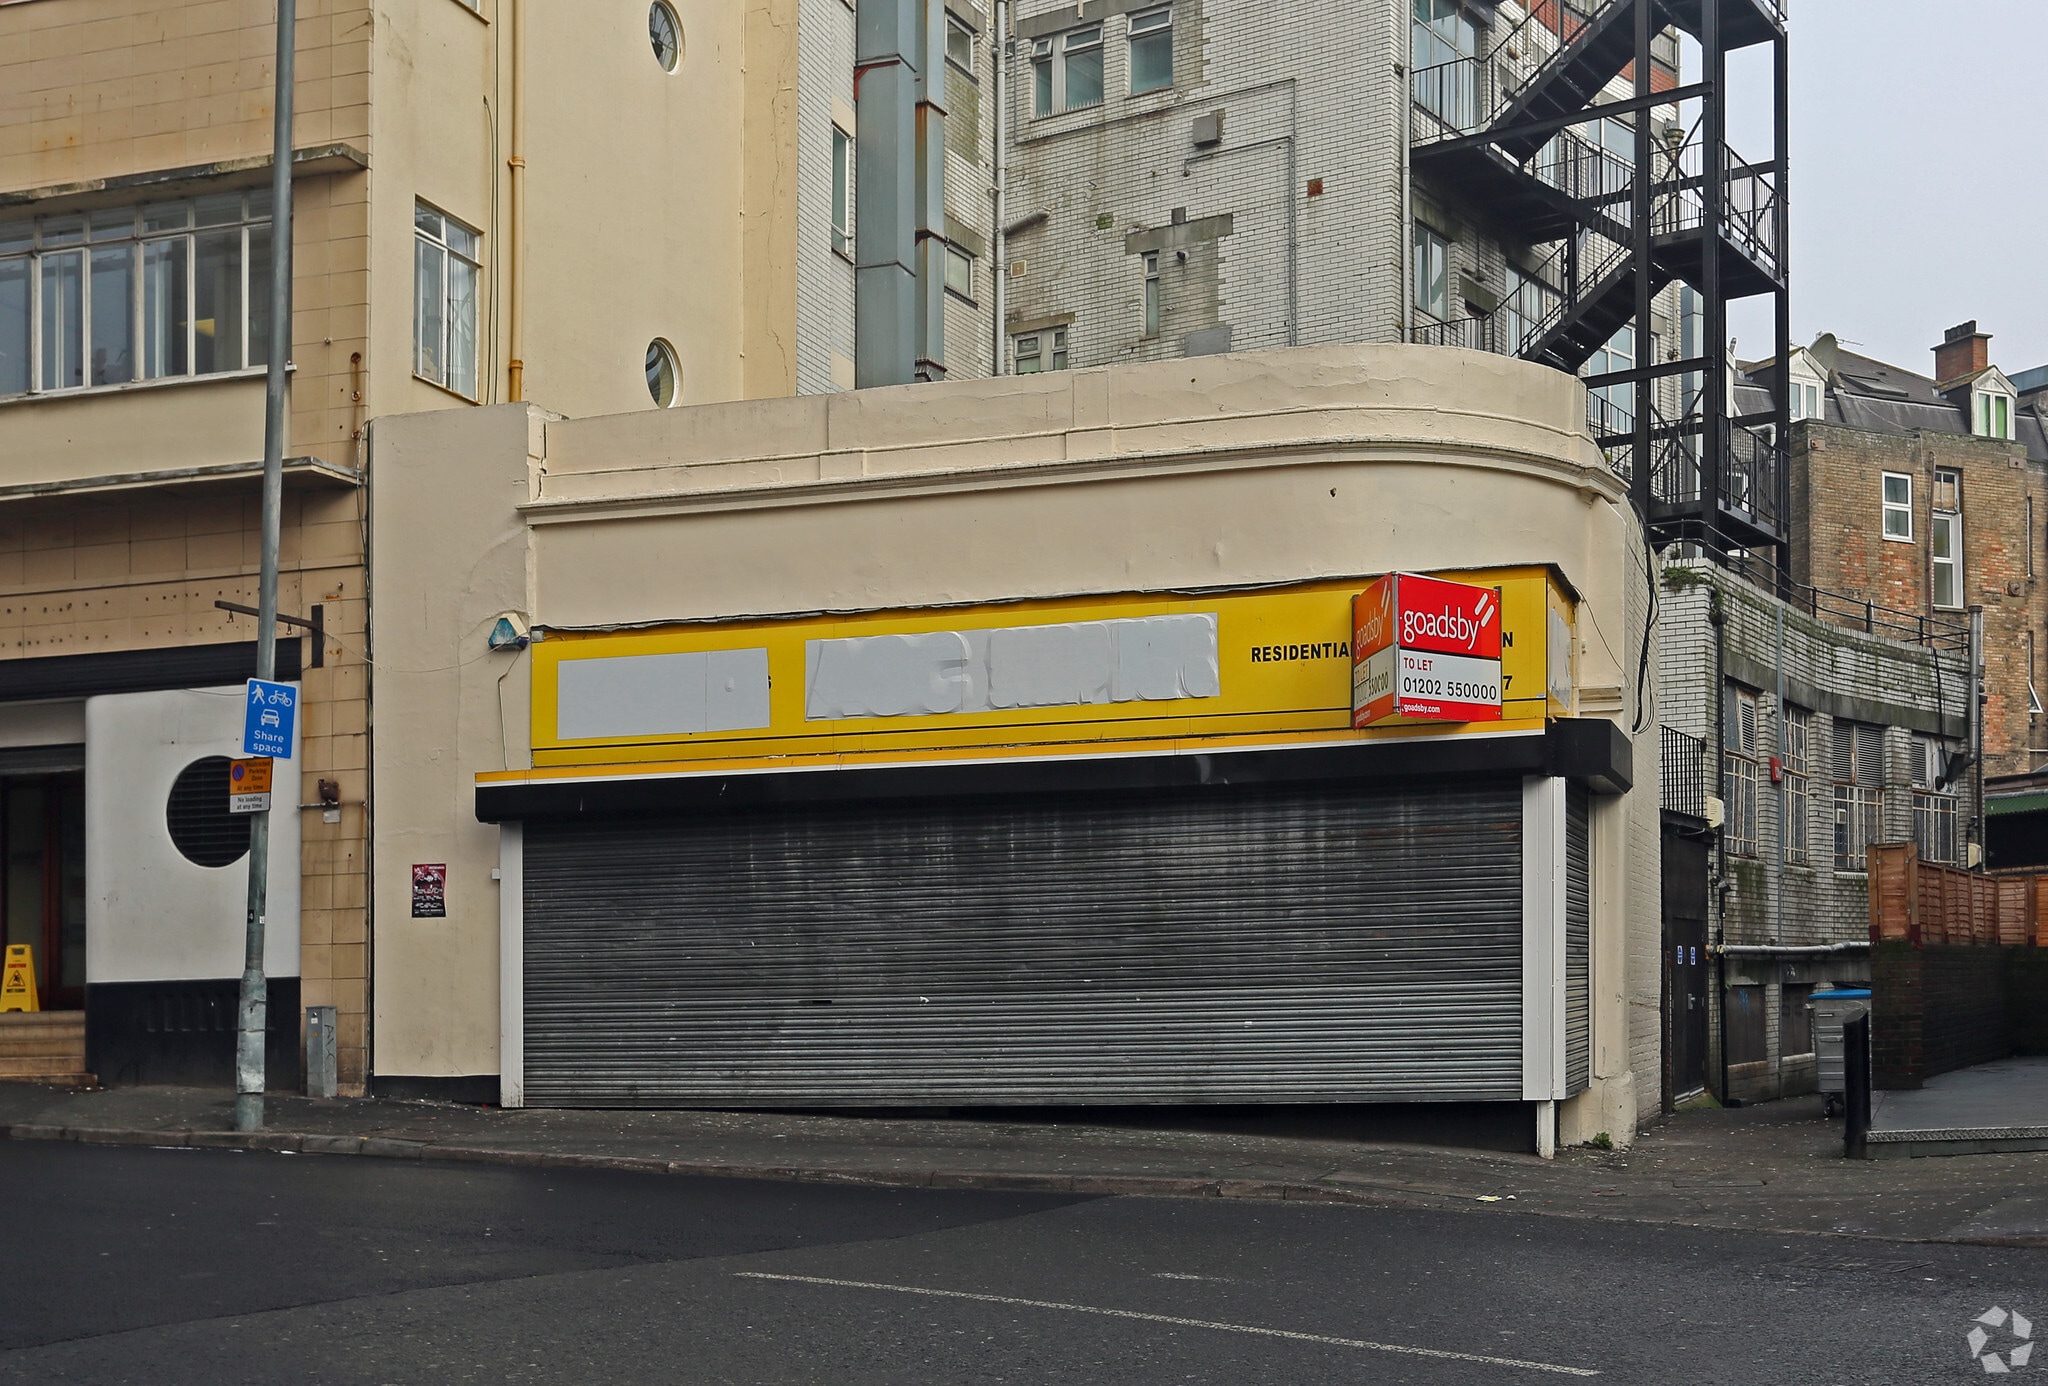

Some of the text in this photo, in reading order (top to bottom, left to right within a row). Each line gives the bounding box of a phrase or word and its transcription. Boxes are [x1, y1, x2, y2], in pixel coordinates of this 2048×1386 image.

[1356, 607, 1384, 660] goadsby
[1403, 605, 1479, 650] goadsby
[1251, 642, 1353, 662] RESIDENTIA
[1403, 656, 1433, 672] TO LET
[1403, 676, 1497, 701] 01202 550000
[1403, 703, 1441, 715] goadsby.com
[254, 730, 284, 742] Share
[253, 743, 283, 754] space
